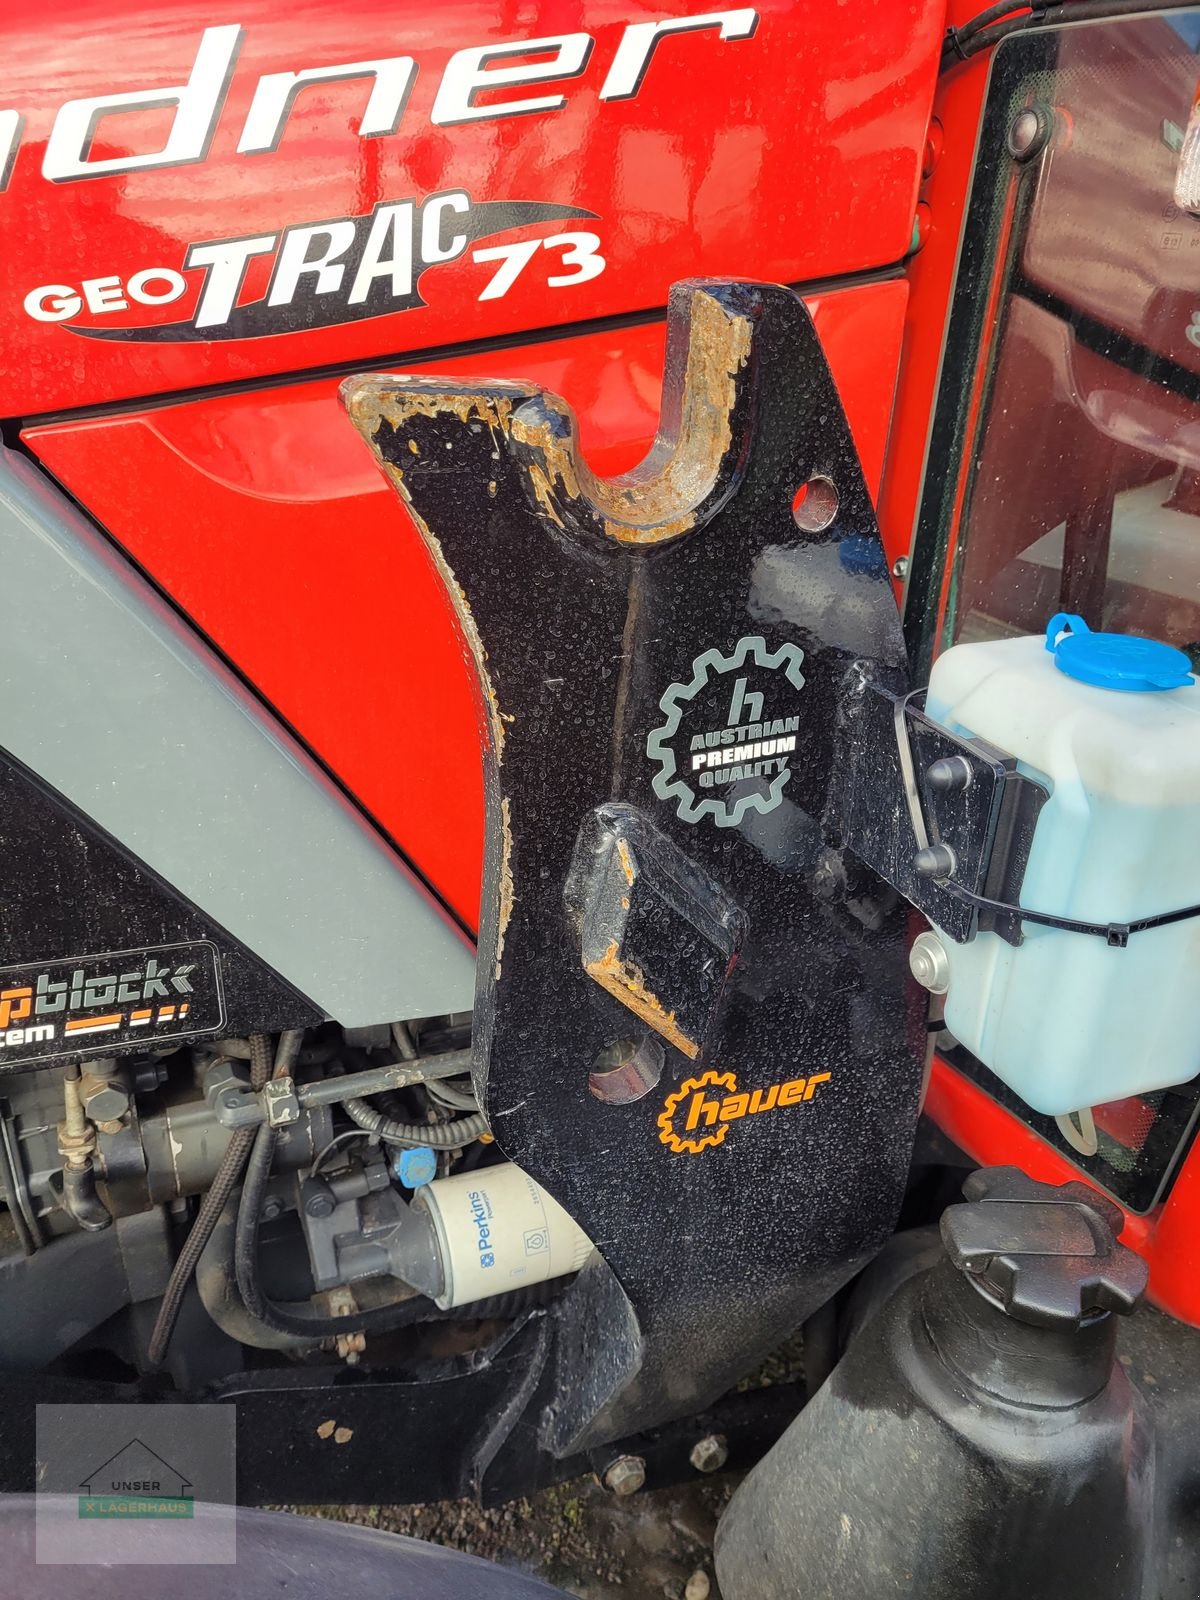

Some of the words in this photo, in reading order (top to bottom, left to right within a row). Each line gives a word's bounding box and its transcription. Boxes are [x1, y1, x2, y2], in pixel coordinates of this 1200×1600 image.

[472, 231, 606, 302] 73
[690, 716, 800, 751] AUSTRIAN
[692, 736, 796, 770] PREMIUM
[699, 757, 789, 788] QUALITY
[686, 1071, 832, 1131] hauer
[468, 1191, 493, 1252] Perkins
